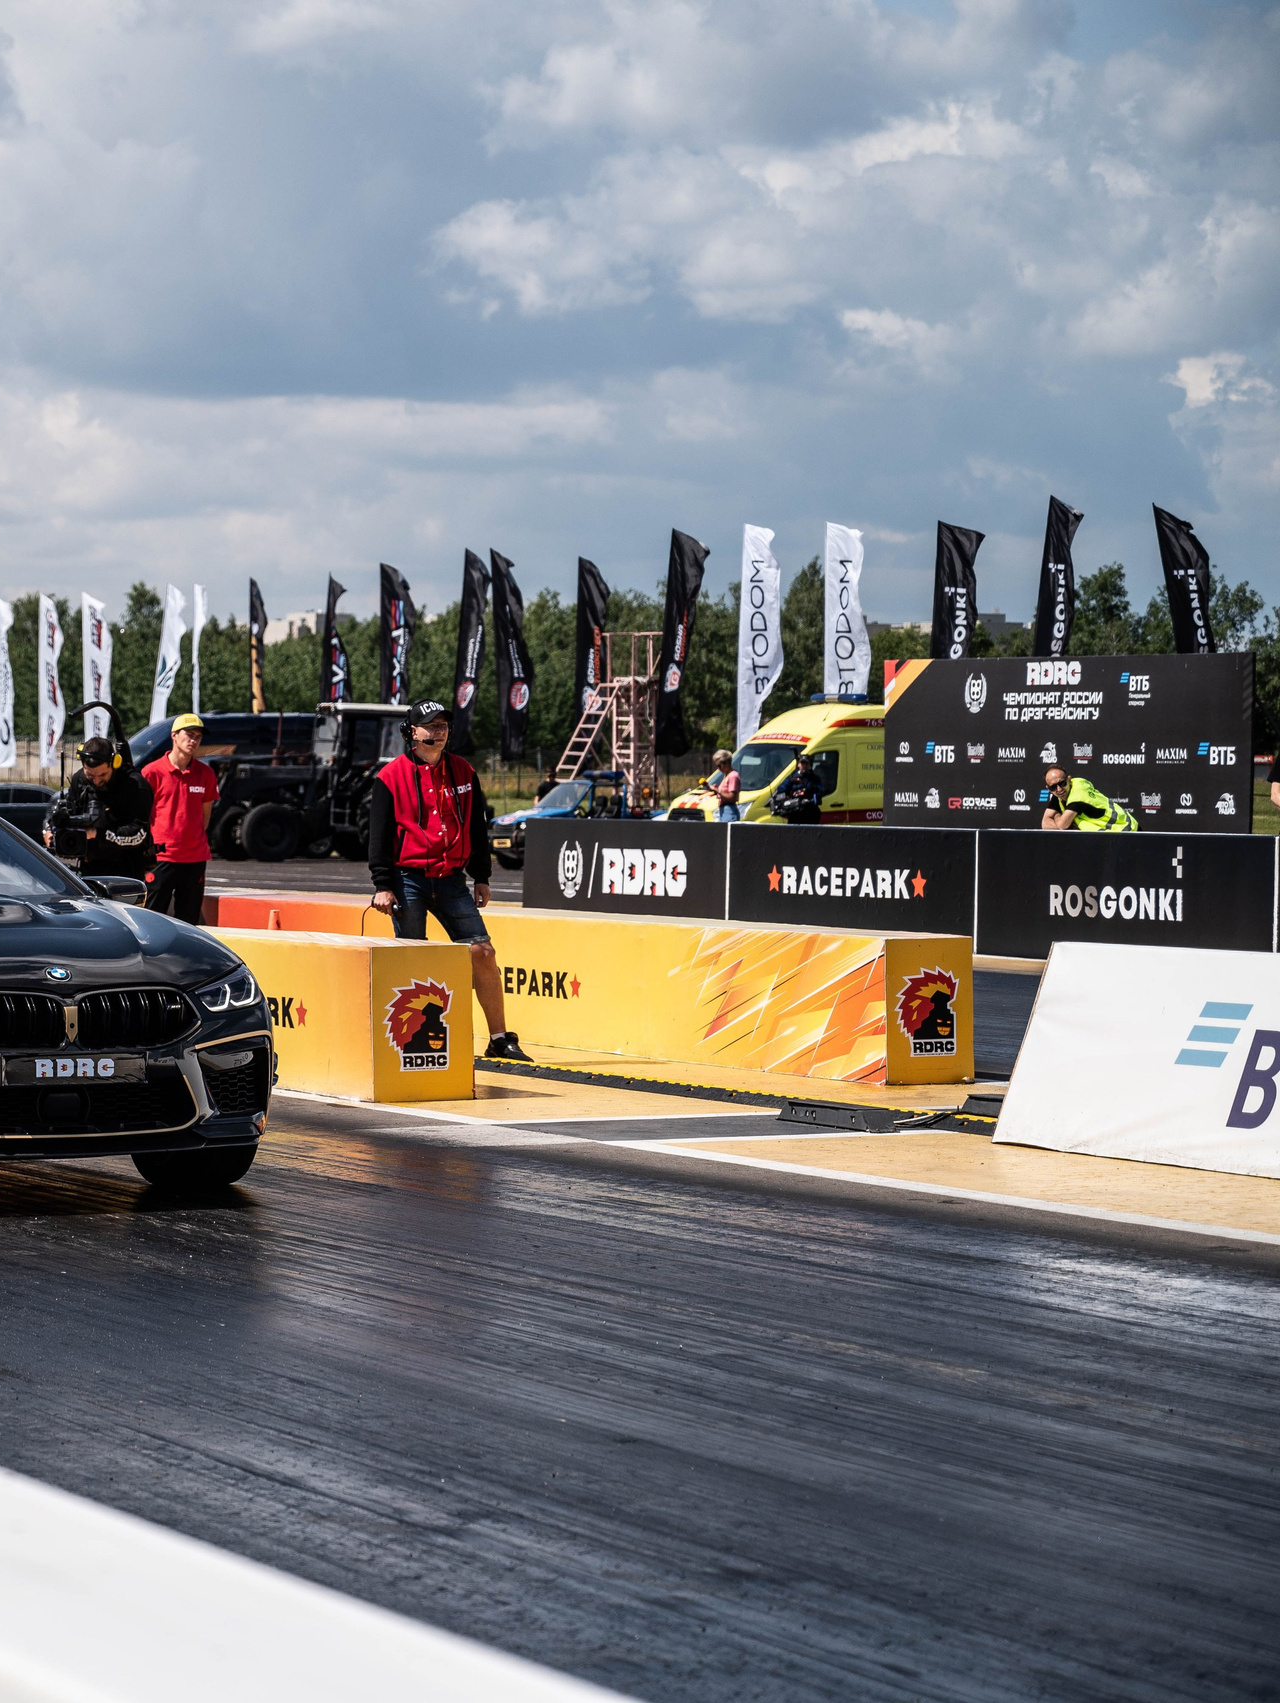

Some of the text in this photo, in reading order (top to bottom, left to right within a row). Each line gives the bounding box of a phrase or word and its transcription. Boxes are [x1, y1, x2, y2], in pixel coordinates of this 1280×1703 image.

[1051, 564, 1066, 657] SGONKI
[673, 624, 684, 662] GOSHA
[1026, 661, 1081, 686] RDRC
[1129, 675, 1150, 692] ВТБ
[1003, 691, 1103, 705] ЧЕМПИОНАТ РОССИИ
[1005, 703, 1100, 721] ПО ДРЭГ-РЕЙСИНГУ
[934, 745, 955, 763] ВТБ
[998, 747, 1026, 758] MAXIM
[1102, 753, 1145, 764] ROSGONKI
[1156, 748, 1188, 759] MAXIM
[1209, 745, 1236, 765] ВТБ
[894, 792, 919, 803] MAXIM
[962, 797, 997, 807] GORACE
[601, 847, 687, 898] RDRC
[782, 865, 910, 899] RACEPARK
[1049, 884, 1183, 922] ROSGONKI
[496, 966, 568, 1000] EPARK
[913, 1041, 955, 1053] RDRC
[34, 1058, 116, 1078] RDRC
[403, 1054, 447, 1068] RDRC
